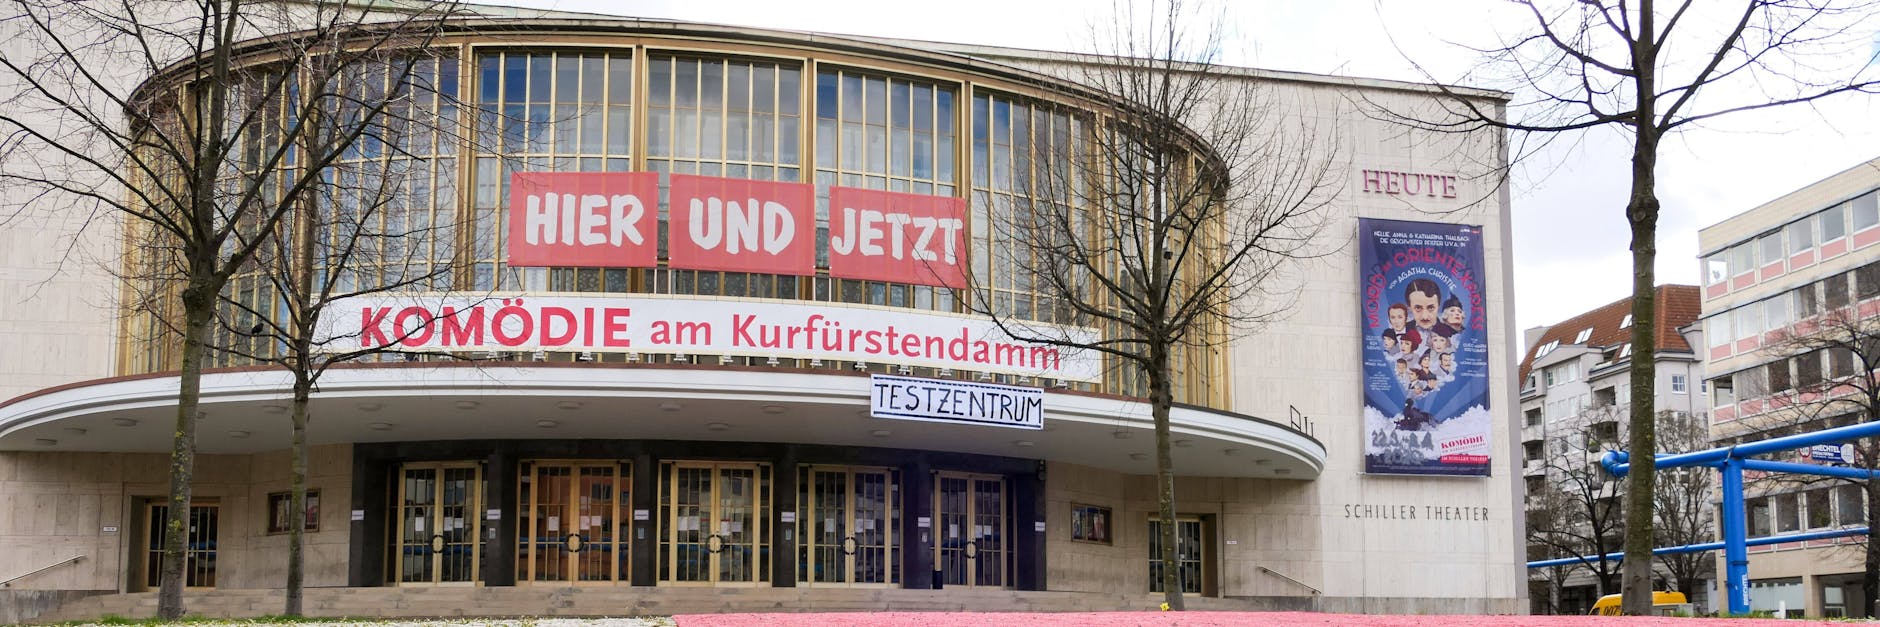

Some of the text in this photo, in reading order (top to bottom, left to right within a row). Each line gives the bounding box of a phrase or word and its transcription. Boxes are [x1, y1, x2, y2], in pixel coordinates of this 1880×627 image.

[1362, 169, 1457, 199] HEUTE
[525, 191, 963, 266] HIER UND JETZT
[1397, 267, 1427, 284] AGATHA
[1427, 267, 1457, 290] CHRISTIE
[1366, 273, 1387, 328] MORD
[361, 298, 1060, 371] KOMÖDIE am Kurfürstendamm
[874, 383, 1043, 424] TESTZENTRUM
[1344, 503, 1489, 521] SCHILLER THEATER
